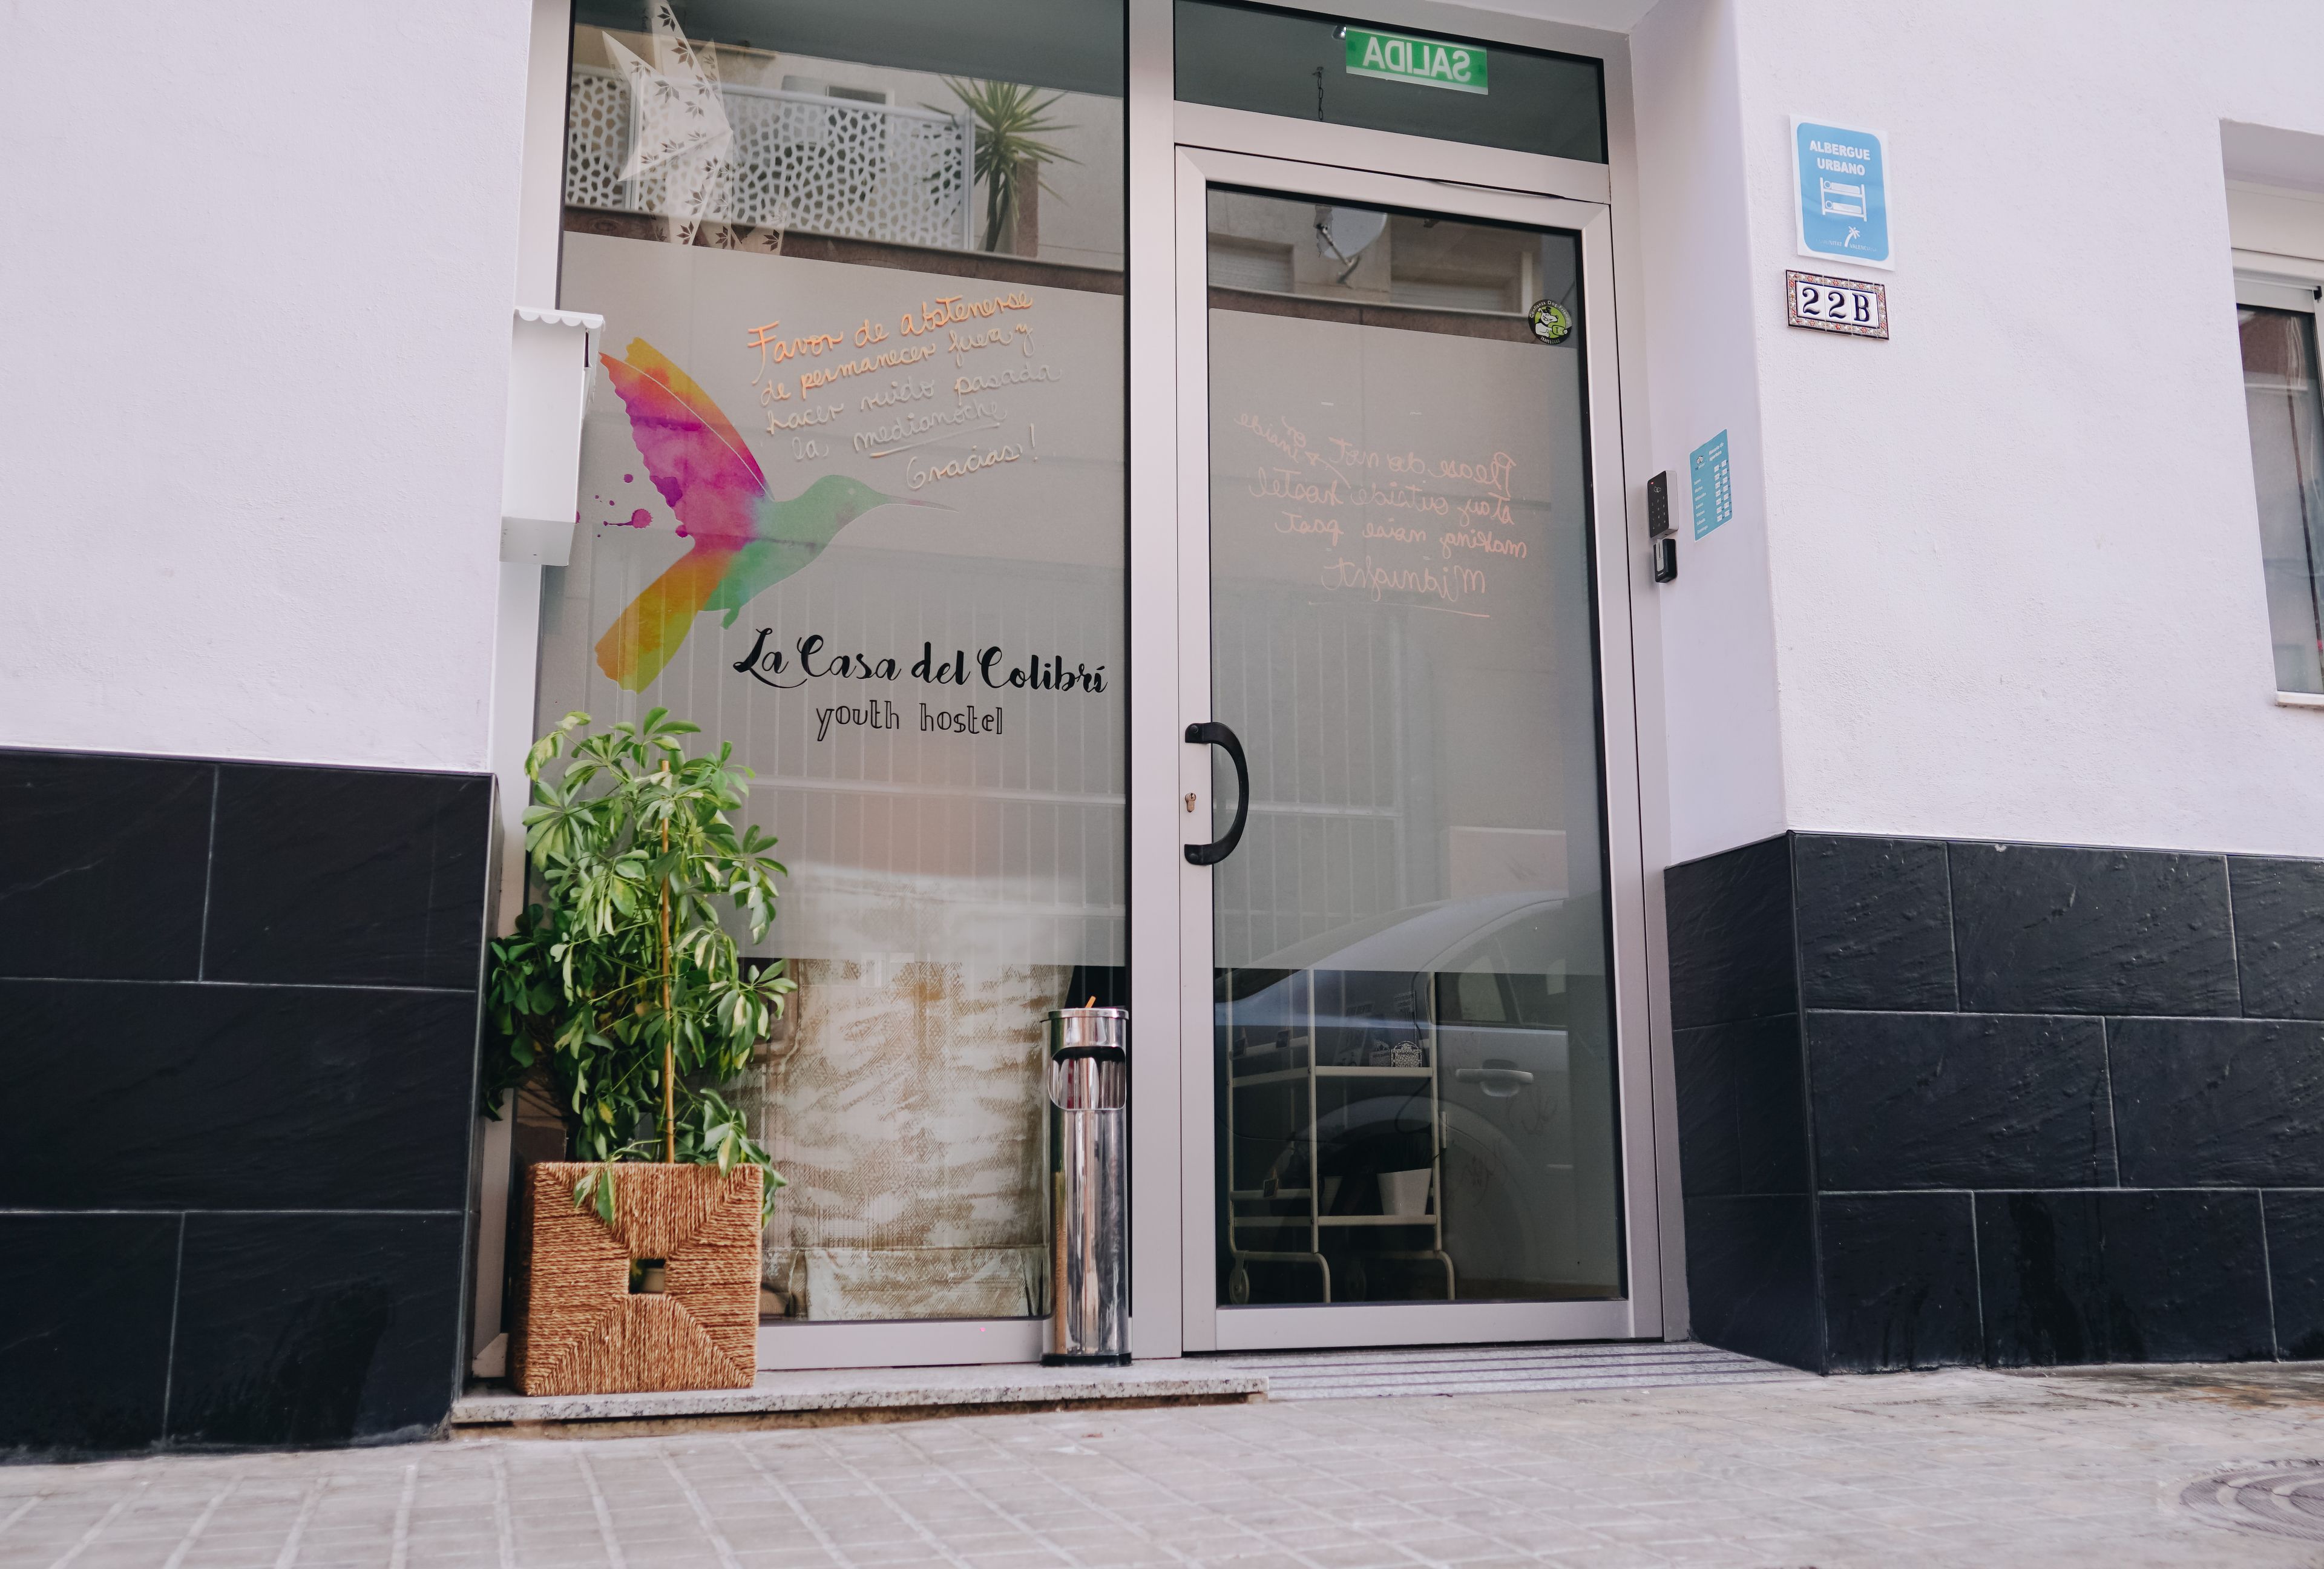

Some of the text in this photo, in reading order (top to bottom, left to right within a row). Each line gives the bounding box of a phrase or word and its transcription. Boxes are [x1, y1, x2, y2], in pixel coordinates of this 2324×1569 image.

[1810, 140, 1871, 161] ALBERGUE
[1817, 157, 1865, 176] URBANO
[1816, 237, 1877, 252] UNITAT VALENCI
[1529, 301, 1546, 318] Confianza
[1802, 286, 1871, 323] 22B
[748, 291, 1033, 385] Favor de abstenerse
[760, 323, 1034, 406] de permanecer fuera y
[766, 362, 1062, 435] hacer ruido pasada
[853, 398, 1007, 449] medianoche
[733, 627, 1108, 693] La Casa del Colibrí
[816, 699, 1002, 742] youth hostel
